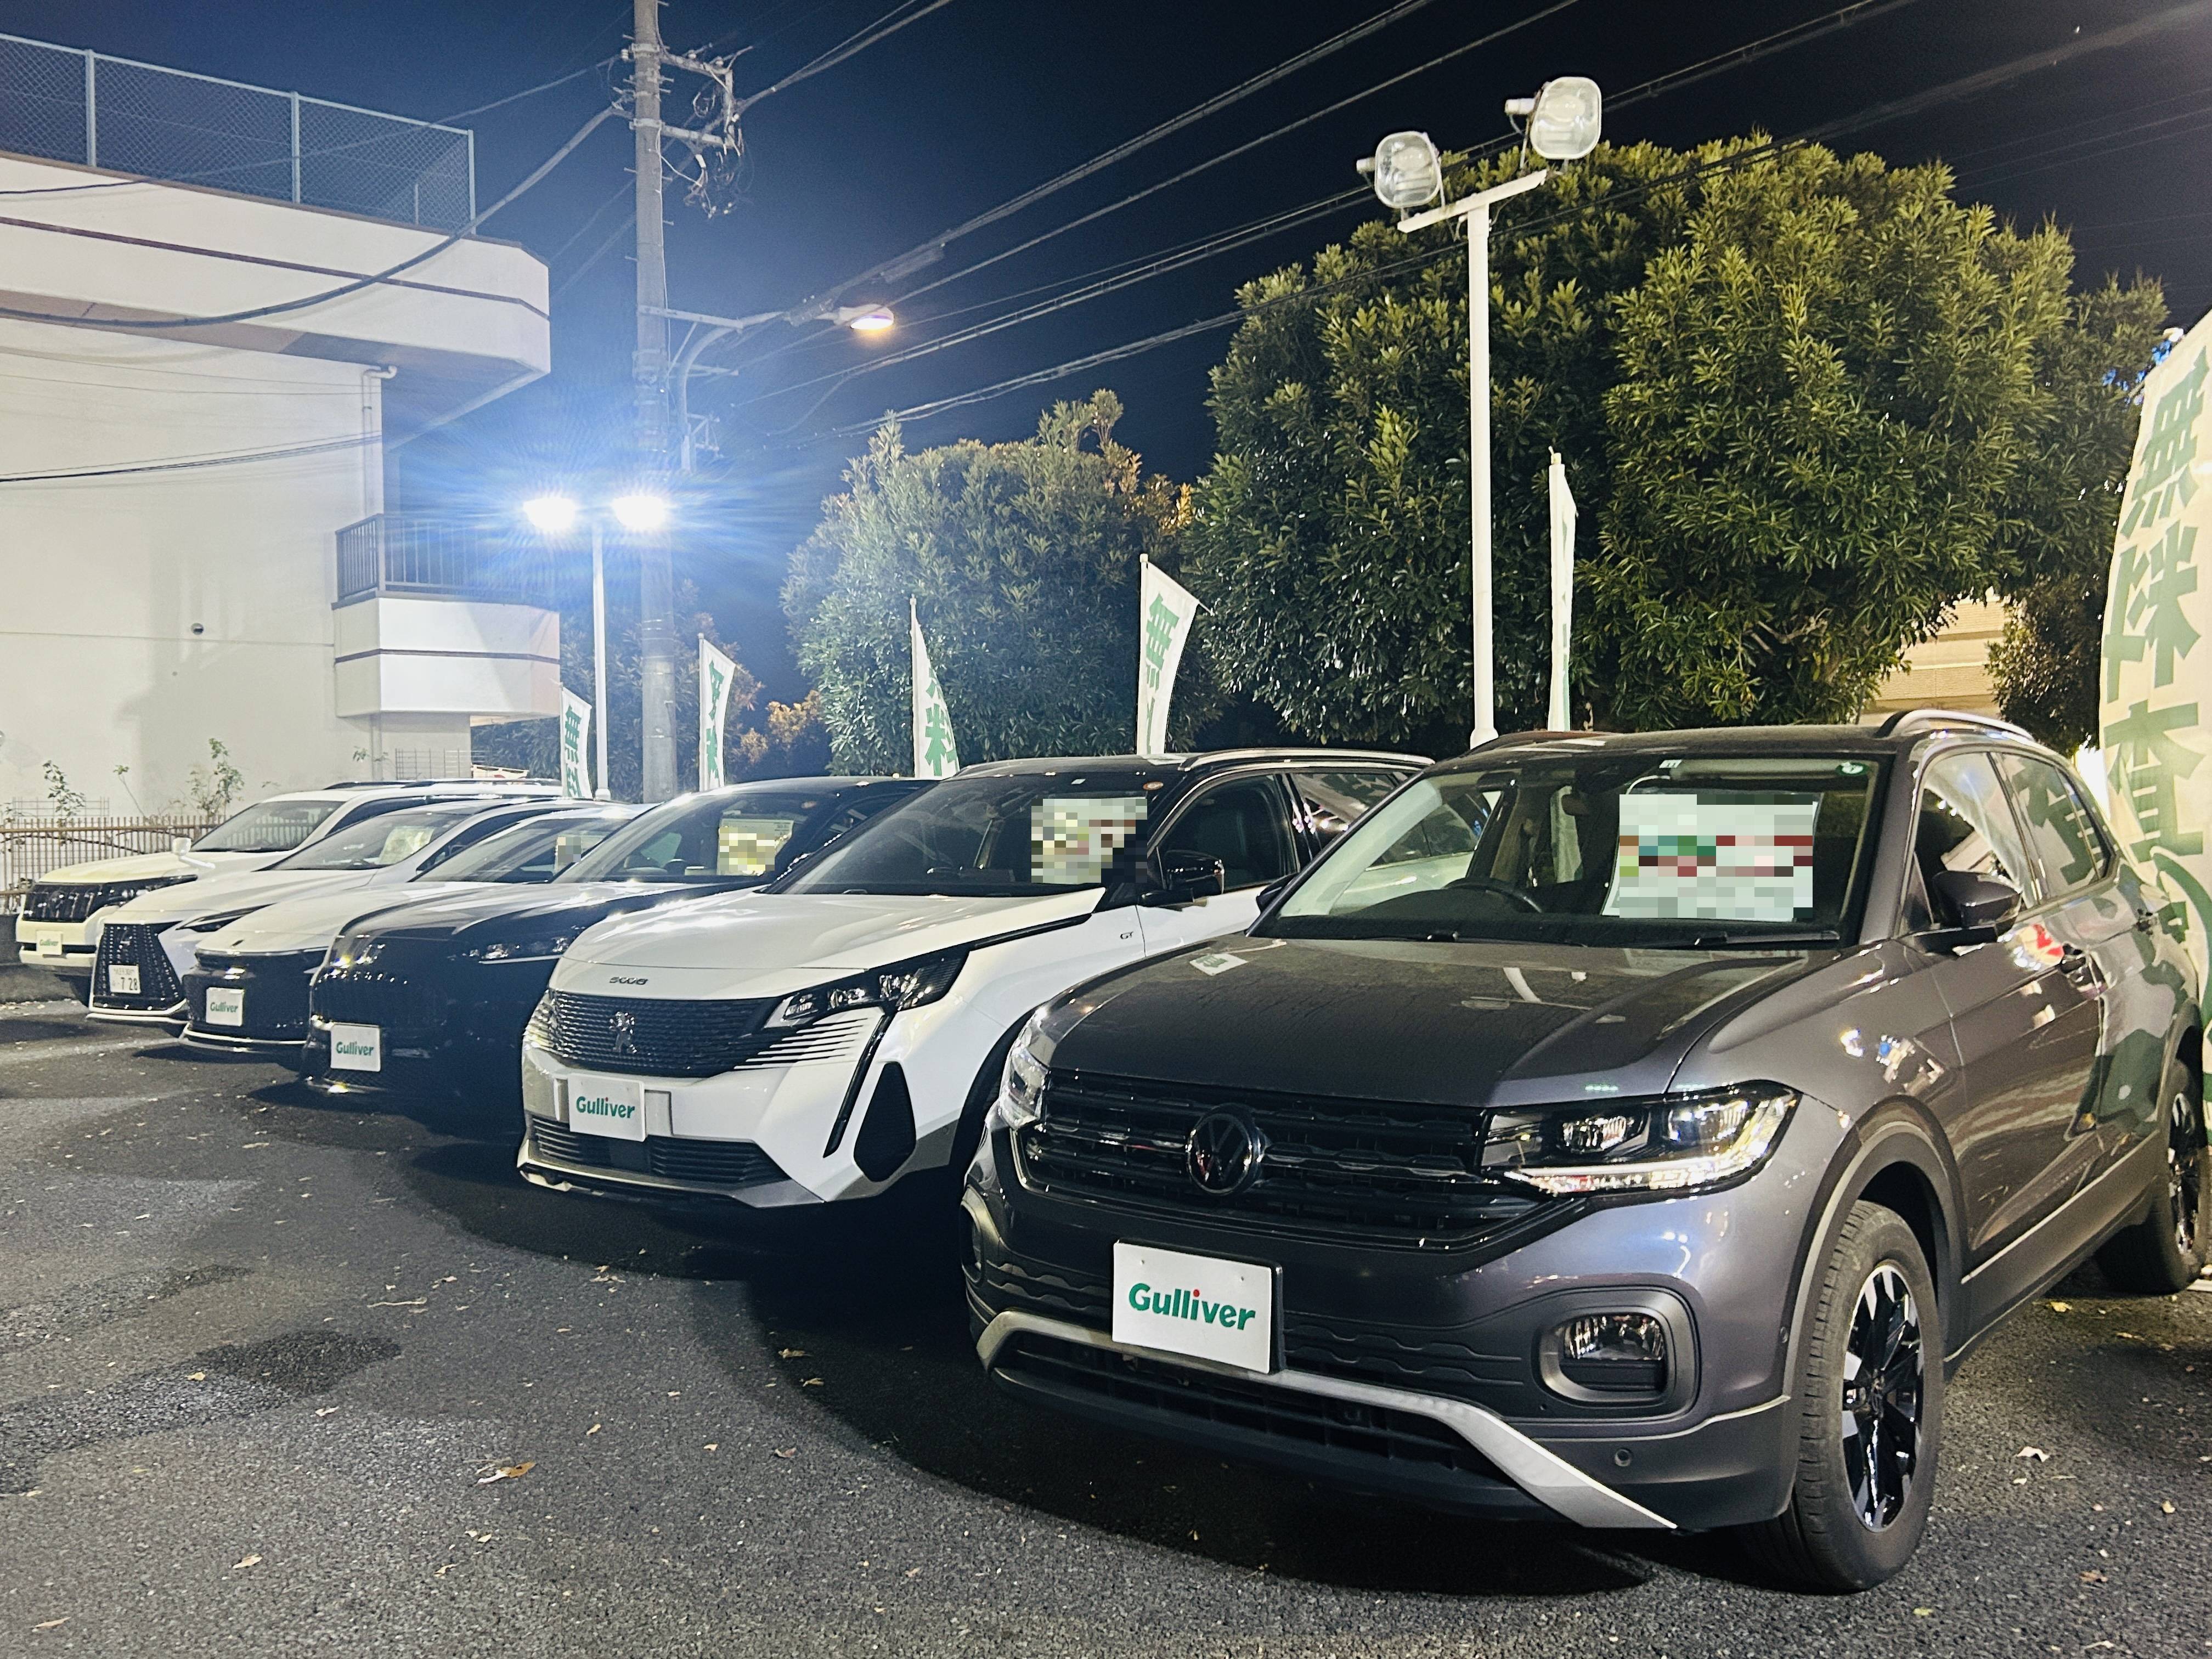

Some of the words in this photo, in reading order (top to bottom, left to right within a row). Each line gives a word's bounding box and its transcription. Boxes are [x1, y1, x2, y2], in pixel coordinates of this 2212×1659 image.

[210, 1001, 238, 1013] Gulliver
[336, 1041, 374, 1056] Gulliver
[576, 1096, 635, 1119] Gulliver
[1128, 1283, 1256, 1331] Gulliver
